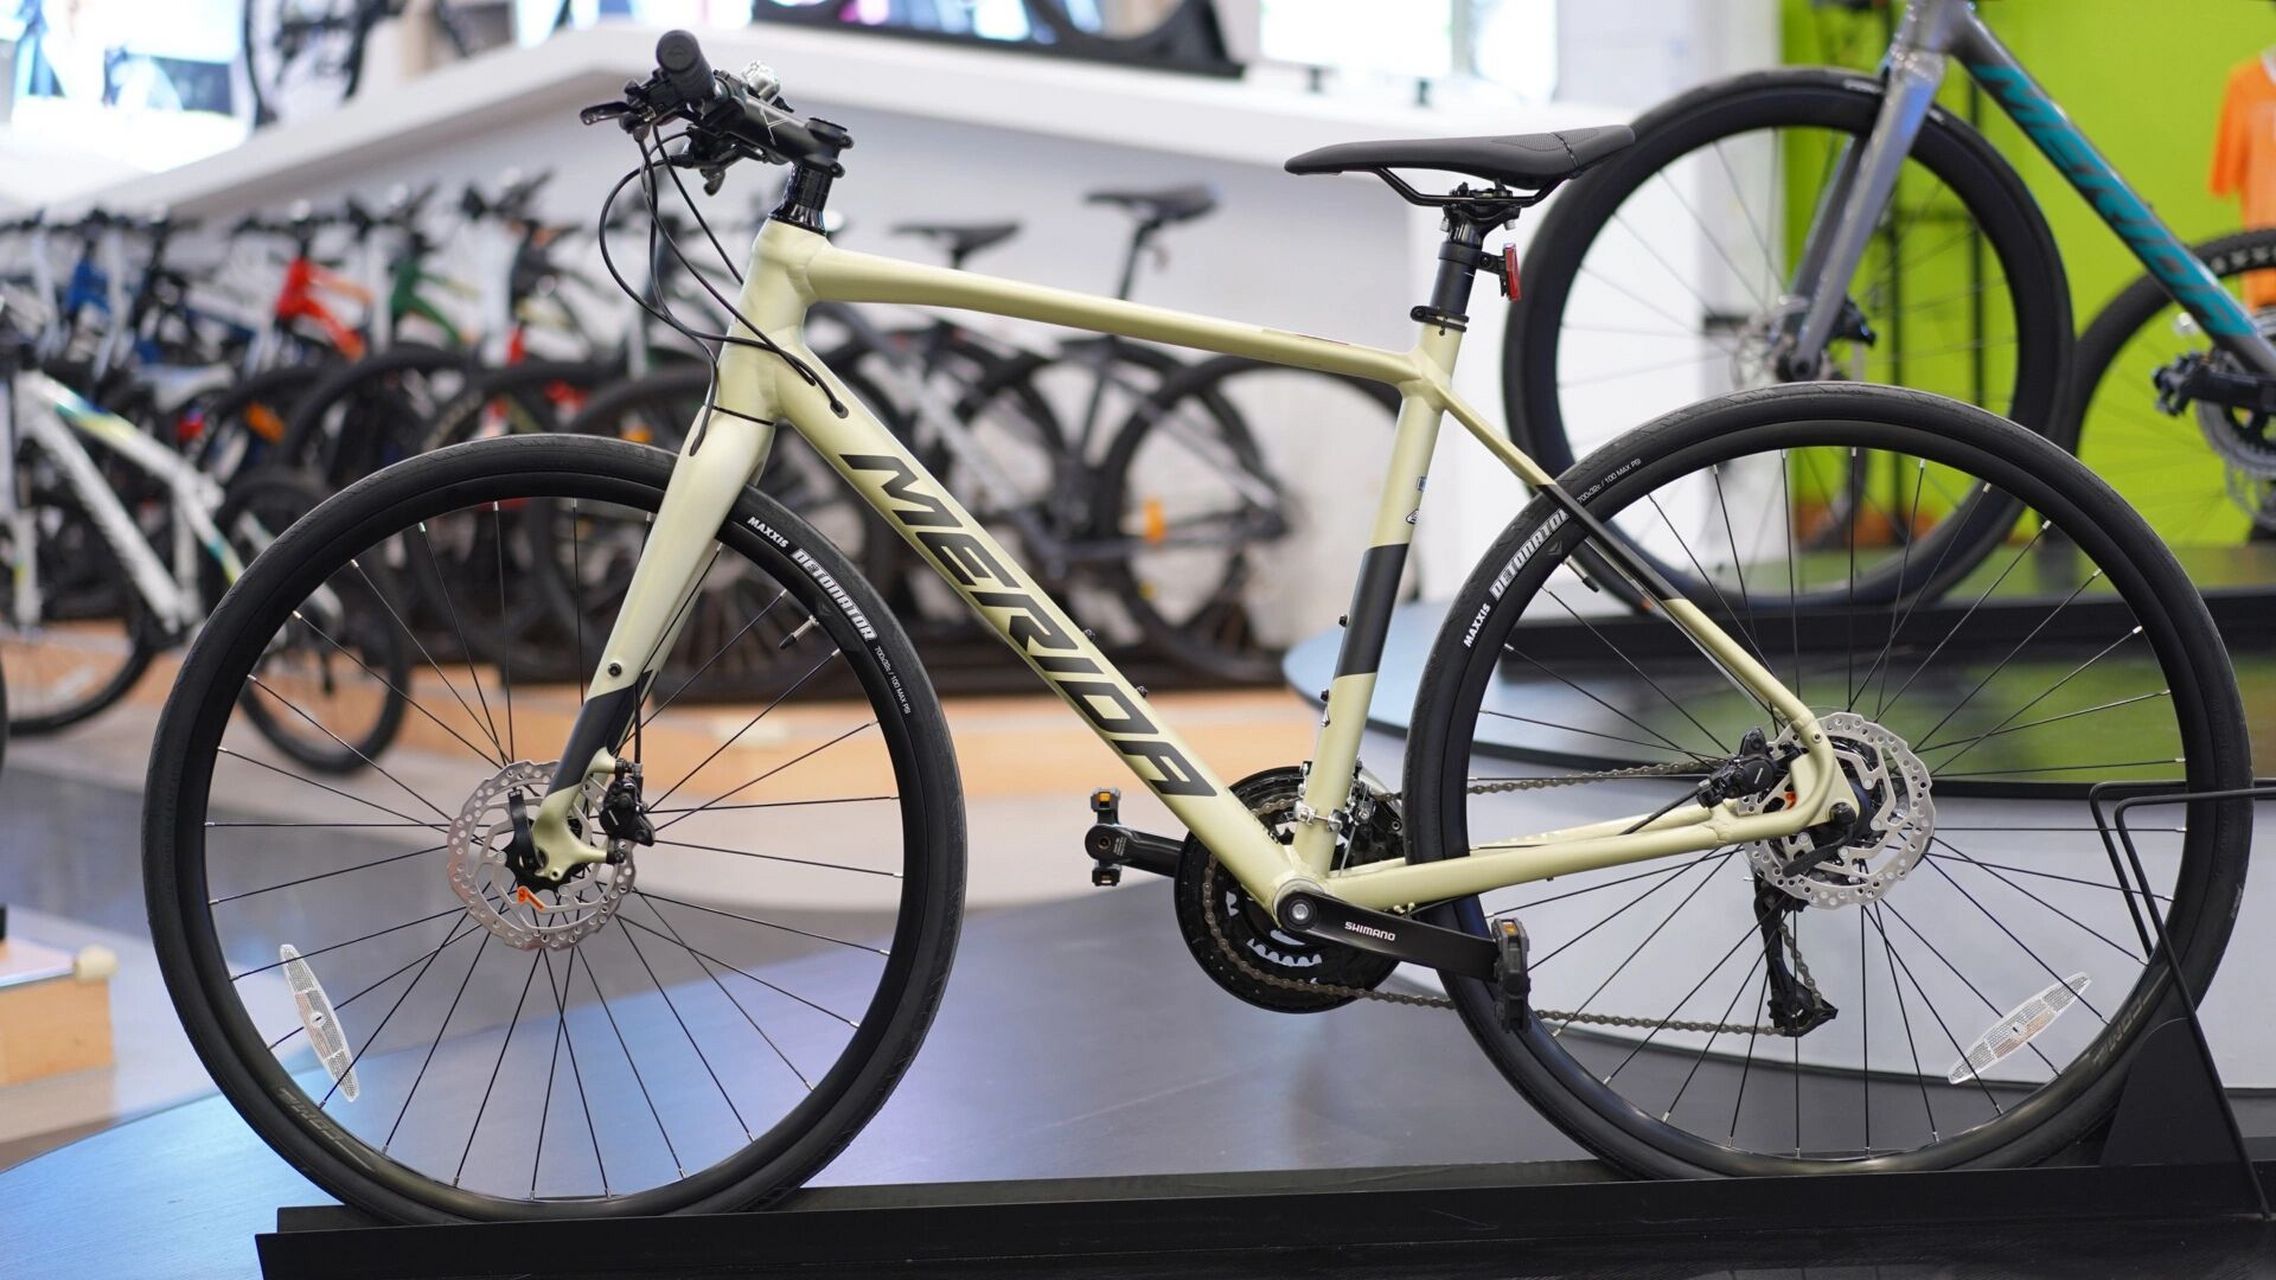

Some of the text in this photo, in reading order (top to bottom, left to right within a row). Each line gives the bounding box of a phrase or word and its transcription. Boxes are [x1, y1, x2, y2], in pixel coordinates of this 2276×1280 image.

[1605, 473, 1617, 483] 100
[1617, 464, 1632, 476] MAX
[748, 516, 879, 642] MAXXIS DETONATOR
[839, 453, 1217, 797] MERIDA
[1463, 603, 1492, 648] MAXXIS
[892, 675, 901, 688] 100
[896, 688, 907, 703] MAX
[902, 703, 912, 714] PSI
[1344, 921, 1396, 942] SHIMANO
